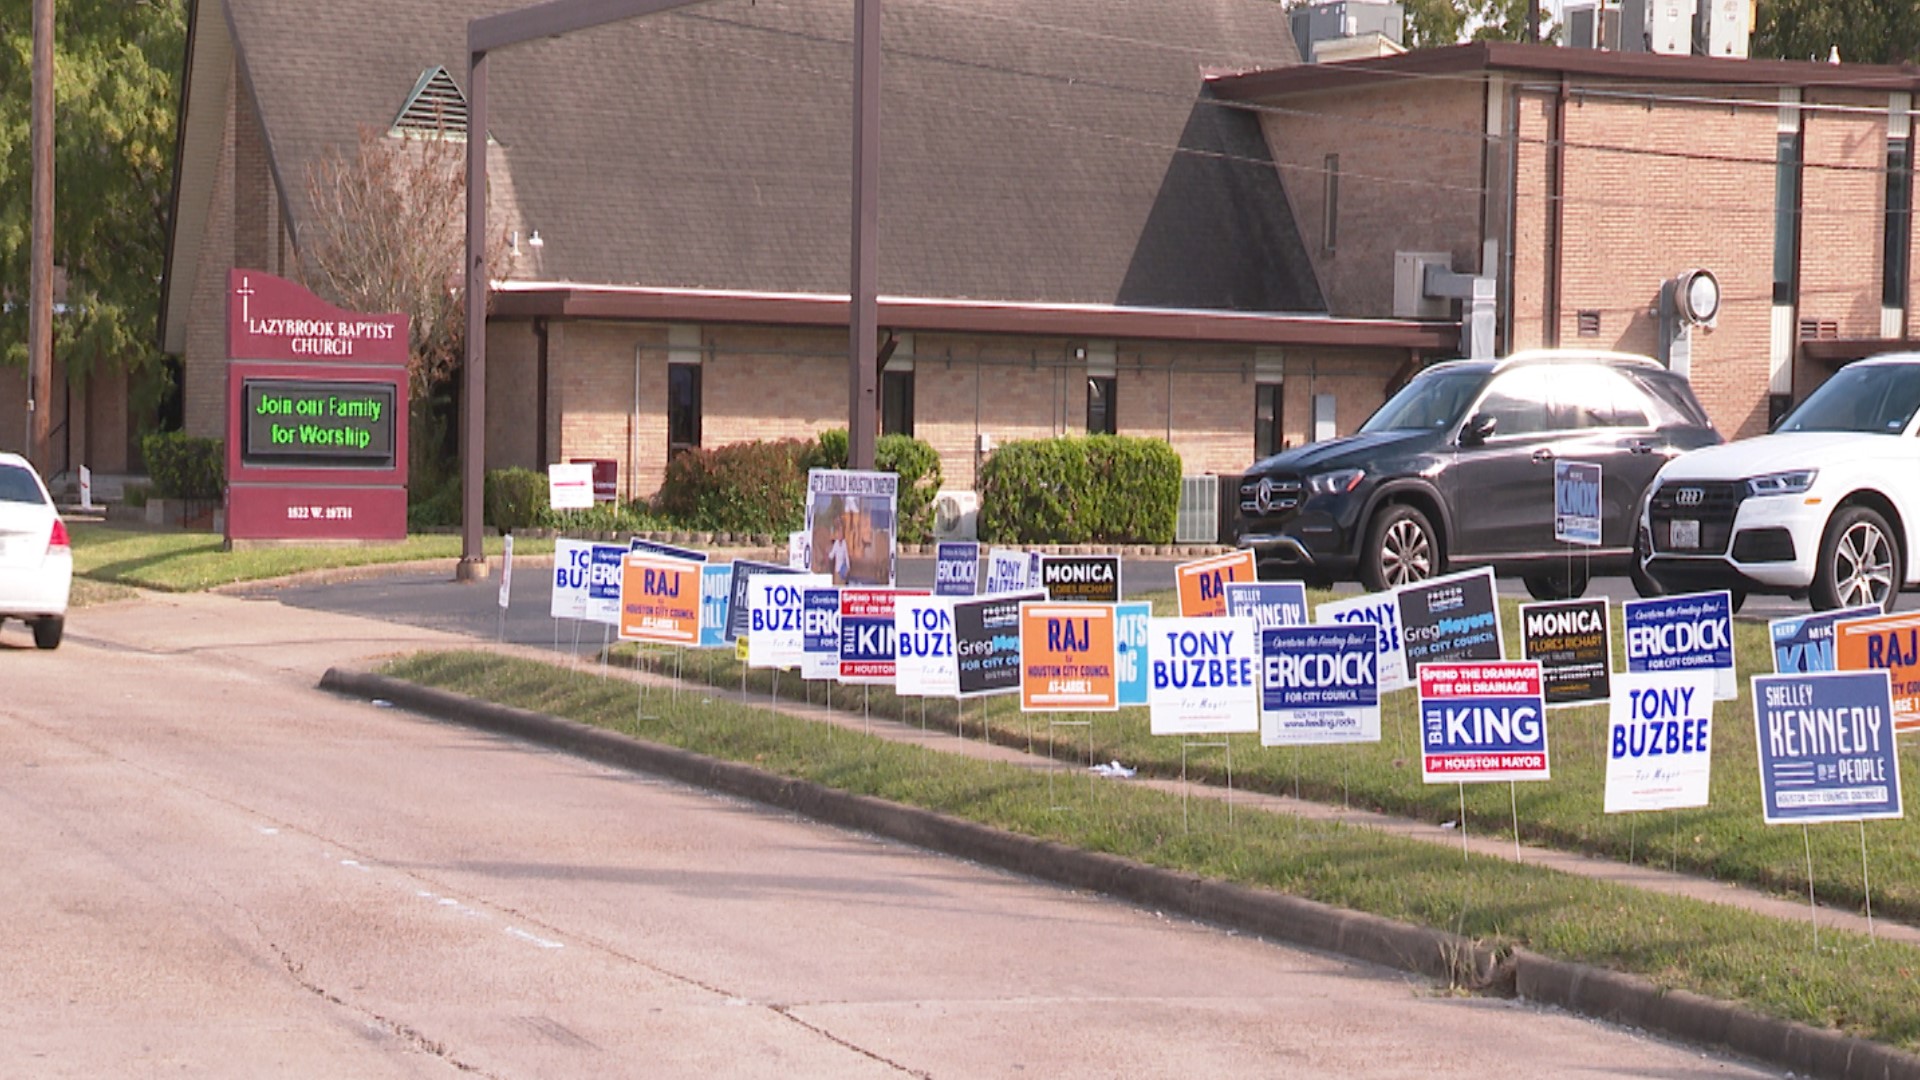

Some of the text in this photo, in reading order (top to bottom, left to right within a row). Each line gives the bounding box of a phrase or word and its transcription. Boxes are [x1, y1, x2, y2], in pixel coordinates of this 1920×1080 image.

[249, 318, 395, 339] LAZYBROOK BAPTIST
[291, 338, 352, 355] CHURCH
[257, 395, 381, 421] Join our Family
[271, 423, 370, 448] for Worship
[1557, 480, 1599, 516] KNOX
[996, 558, 1022, 579] TONY
[1045, 564, 1114, 583] MONICA
[644, 568, 680, 598] RAJ
[1047, 617, 1089, 652] RAJ
[1527, 608, 1603, 638] MONICA
[1808, 625, 1833, 640] MIK
[1165, 629, 1235, 658] TONY
[1408, 632, 1495, 658] FOR CITY COUNCIL
[1529, 638, 1564, 653] FLORES
[1777, 639, 1834, 673] KN
[1868, 628, 1918, 669] RAJ
[1028, 665, 1062, 677] HOUSTON
[1063, 665, 1079, 677] CITY
[1153, 657, 1253, 690] BUZBEE
[1421, 667, 1459, 681] SPEND
[1460, 668, 1481, 680] THE
[1482, 667, 1537, 680] DRAINAGE
[1648, 654, 1715, 669] FOR CITY COUNCIL
[1285, 688, 1359, 703] FOR CITY COUNCIL
[1433, 681, 1529, 695] FEE ON DRAINAGE
[1766, 684, 1813, 707] SHELLEY
[1629, 686, 1695, 720] TONY
[1445, 706, 1541, 746] KING
[1612, 718, 1709, 760] BUZBEE
[1767, 706, 1881, 757] KENNEDY
[1444, 757, 1500, 771] HOUSTON
[1501, 756, 1542, 768] MAYOR
[1838, 757, 1887, 784] PEOPLE
